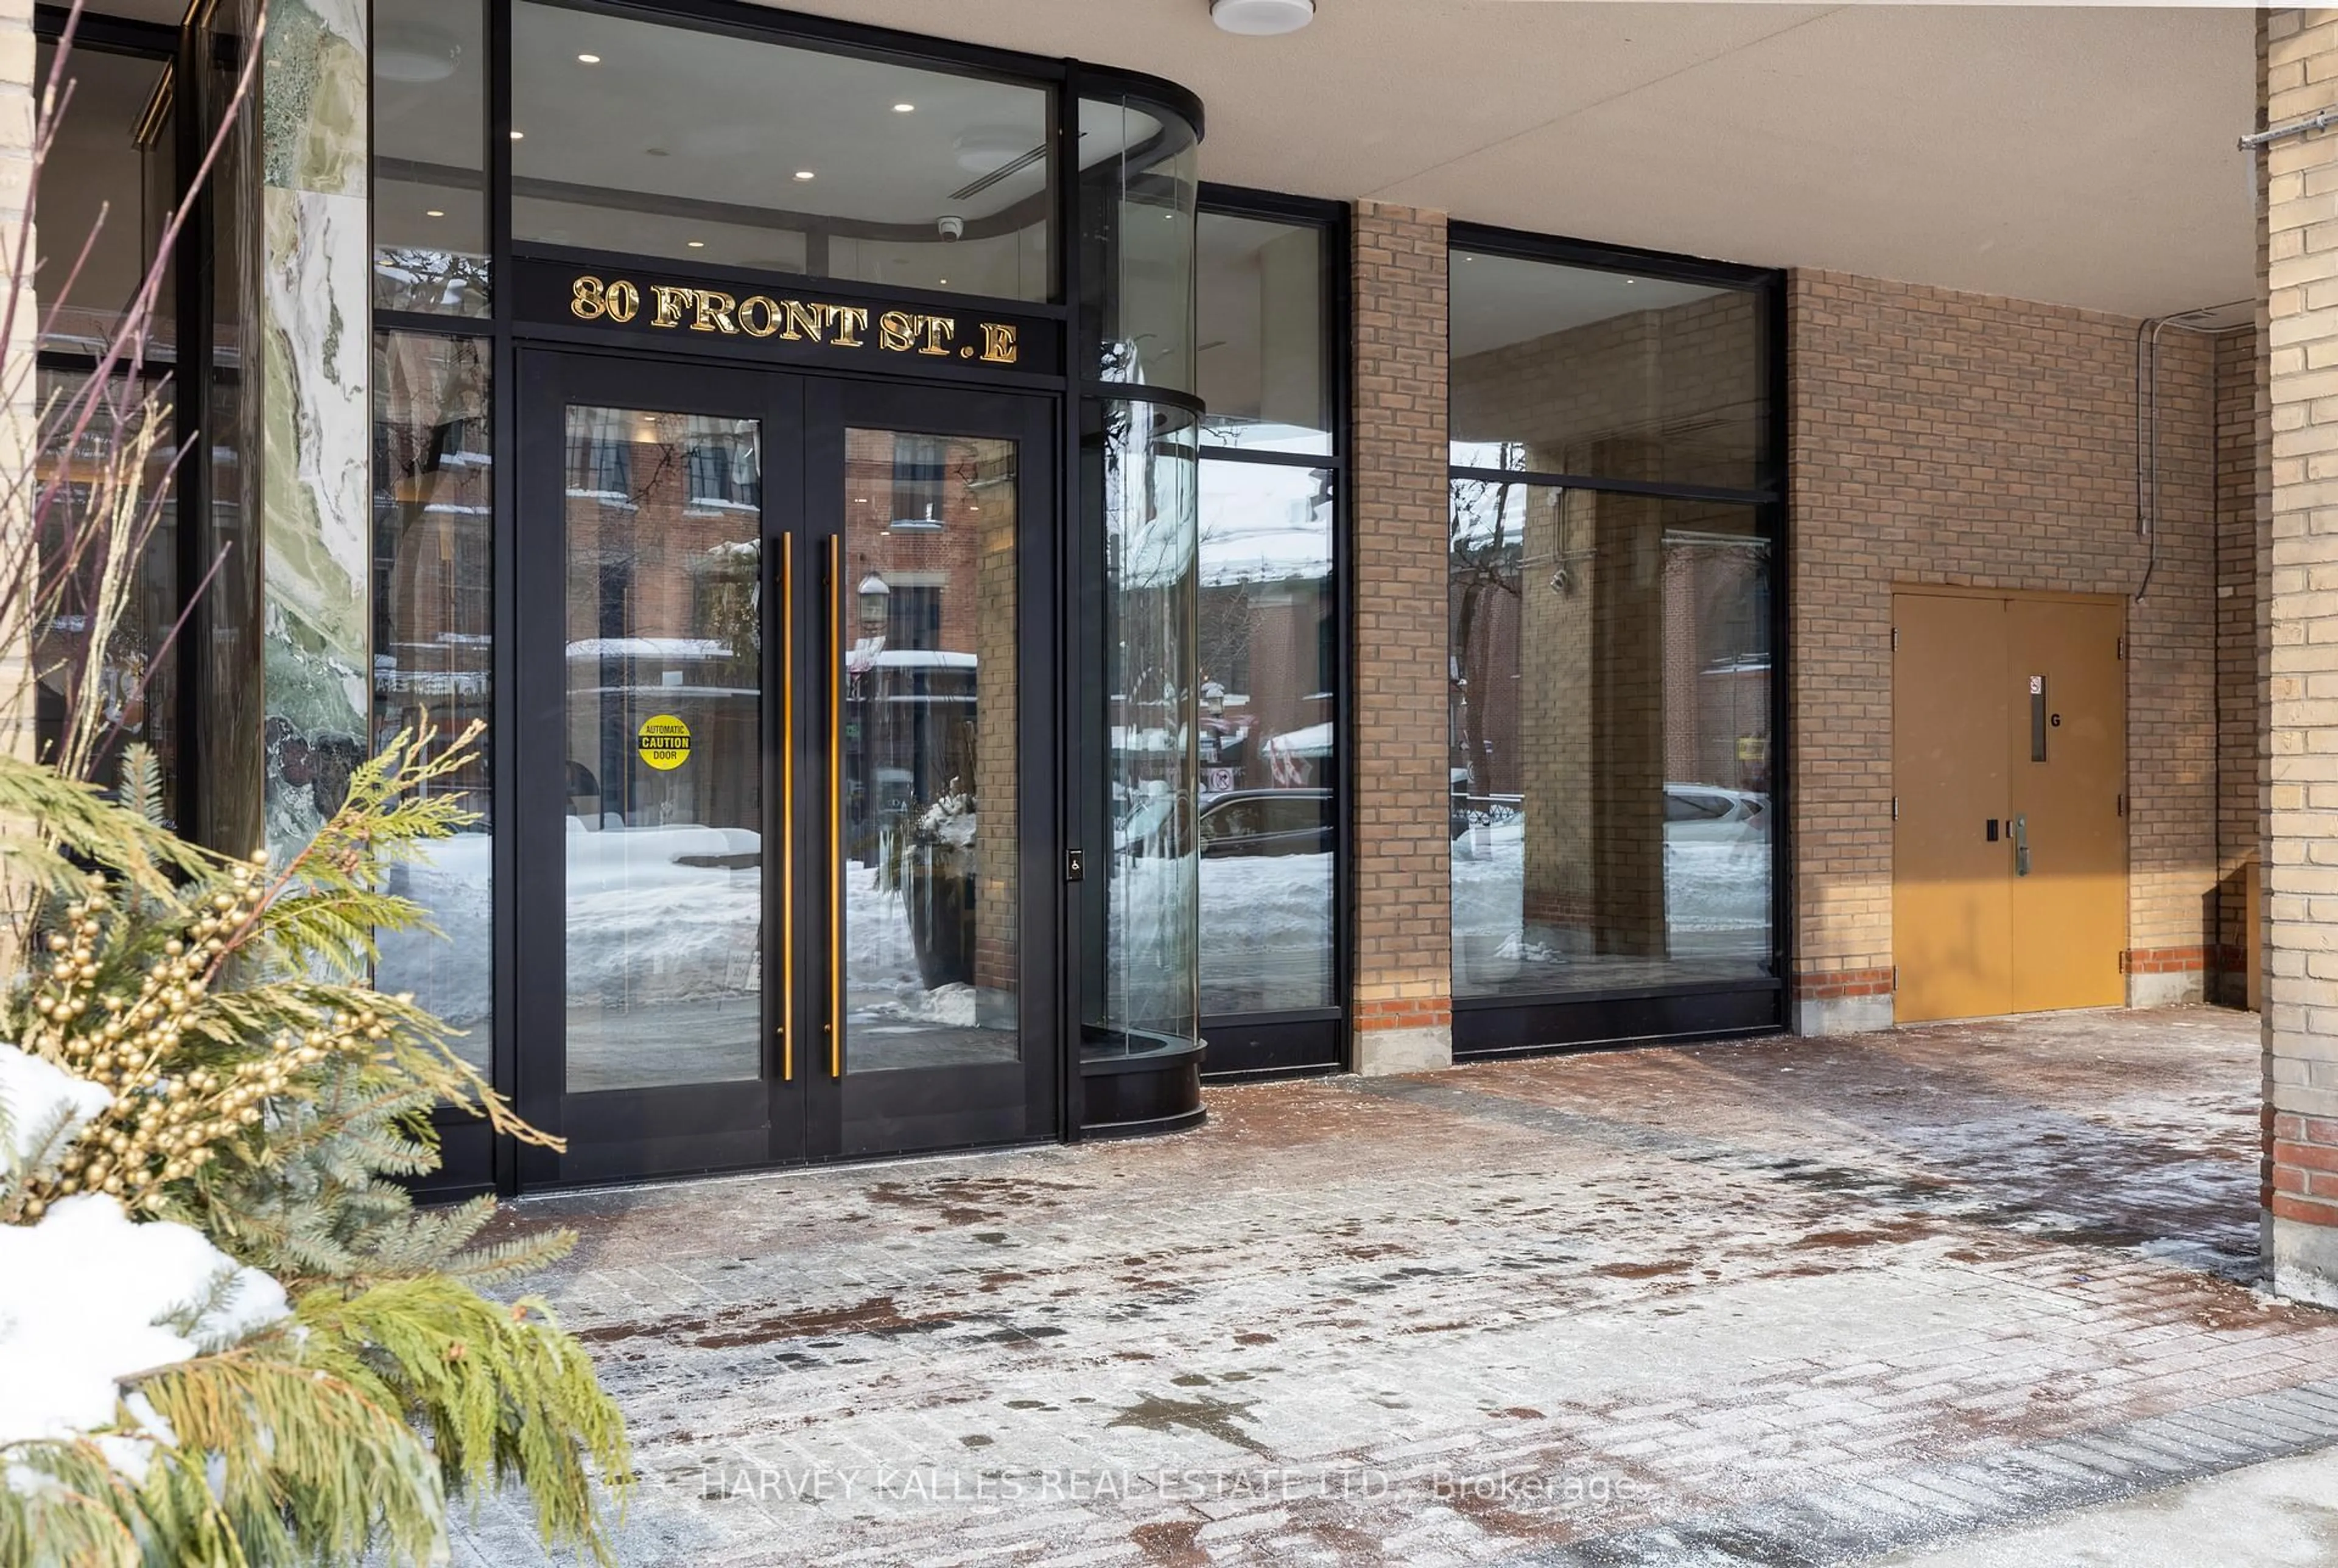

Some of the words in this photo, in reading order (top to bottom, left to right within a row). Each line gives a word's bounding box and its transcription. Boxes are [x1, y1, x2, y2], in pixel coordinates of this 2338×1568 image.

[570, 275, 640, 323] 80
[650, 284, 868, 347] FRONT
[2051, 713, 2062, 727] G
[646, 725, 684, 734] AUTOMATIC
[642, 737, 689, 748] CAUTION
[653, 751, 677, 760] DOOR
